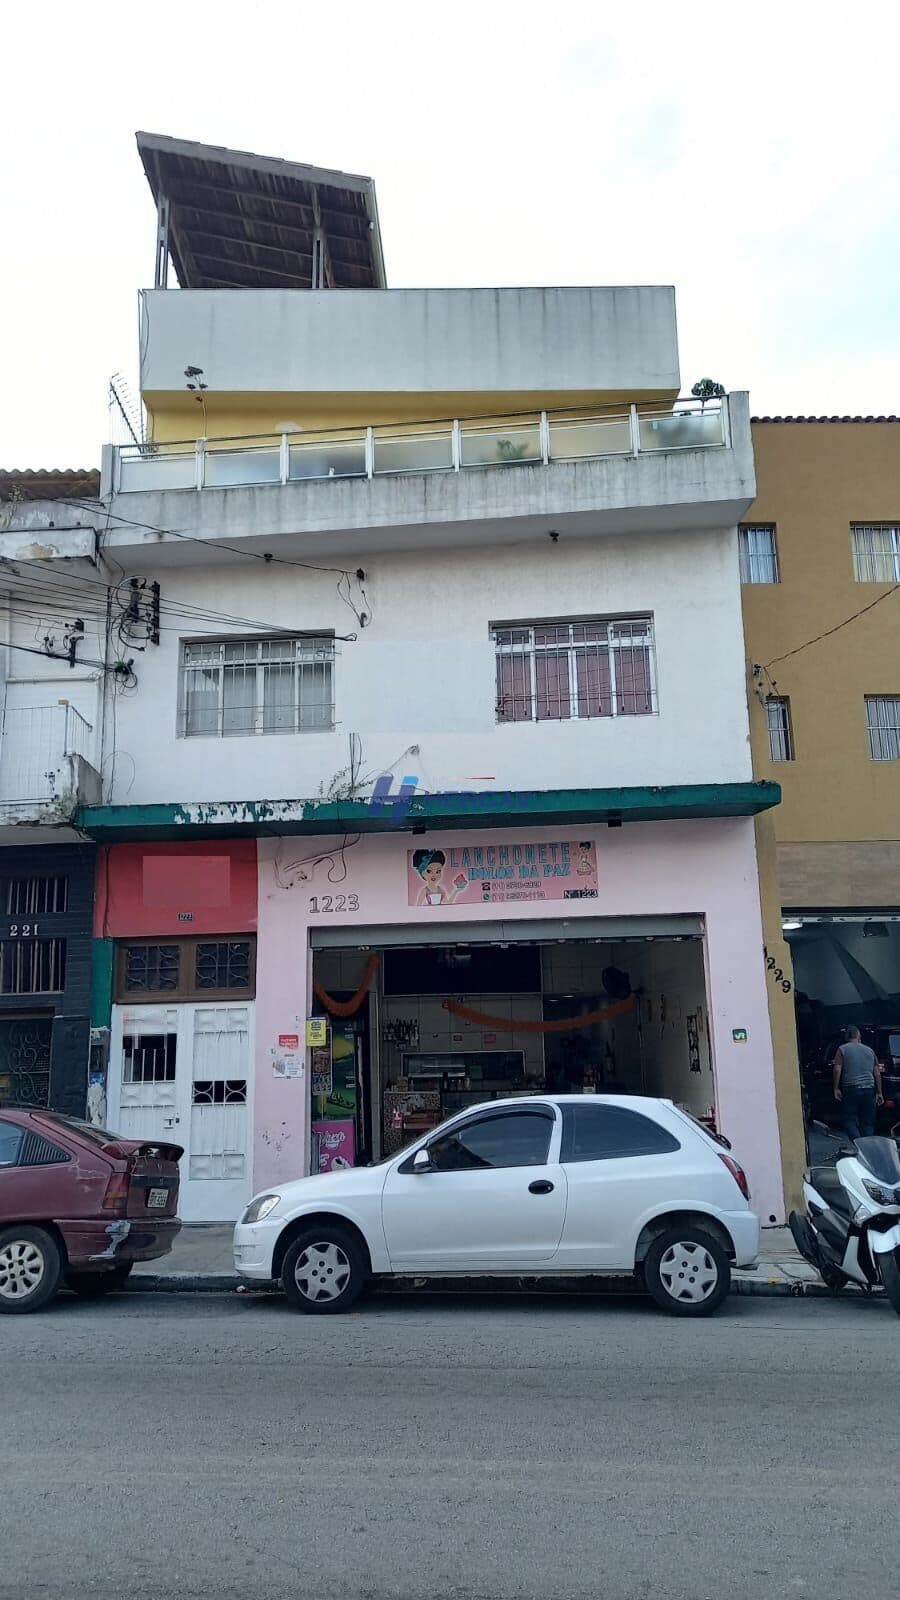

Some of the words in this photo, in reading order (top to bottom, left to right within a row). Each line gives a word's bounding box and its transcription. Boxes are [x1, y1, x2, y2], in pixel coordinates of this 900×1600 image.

[450, 843, 571, 867] LANCHONETE
[468, 865, 515, 880] BOLOS
[519, 863, 539, 878] DA
[543, 860, 572, 877] PAZ
[309, 893, 360, 914] 1223
